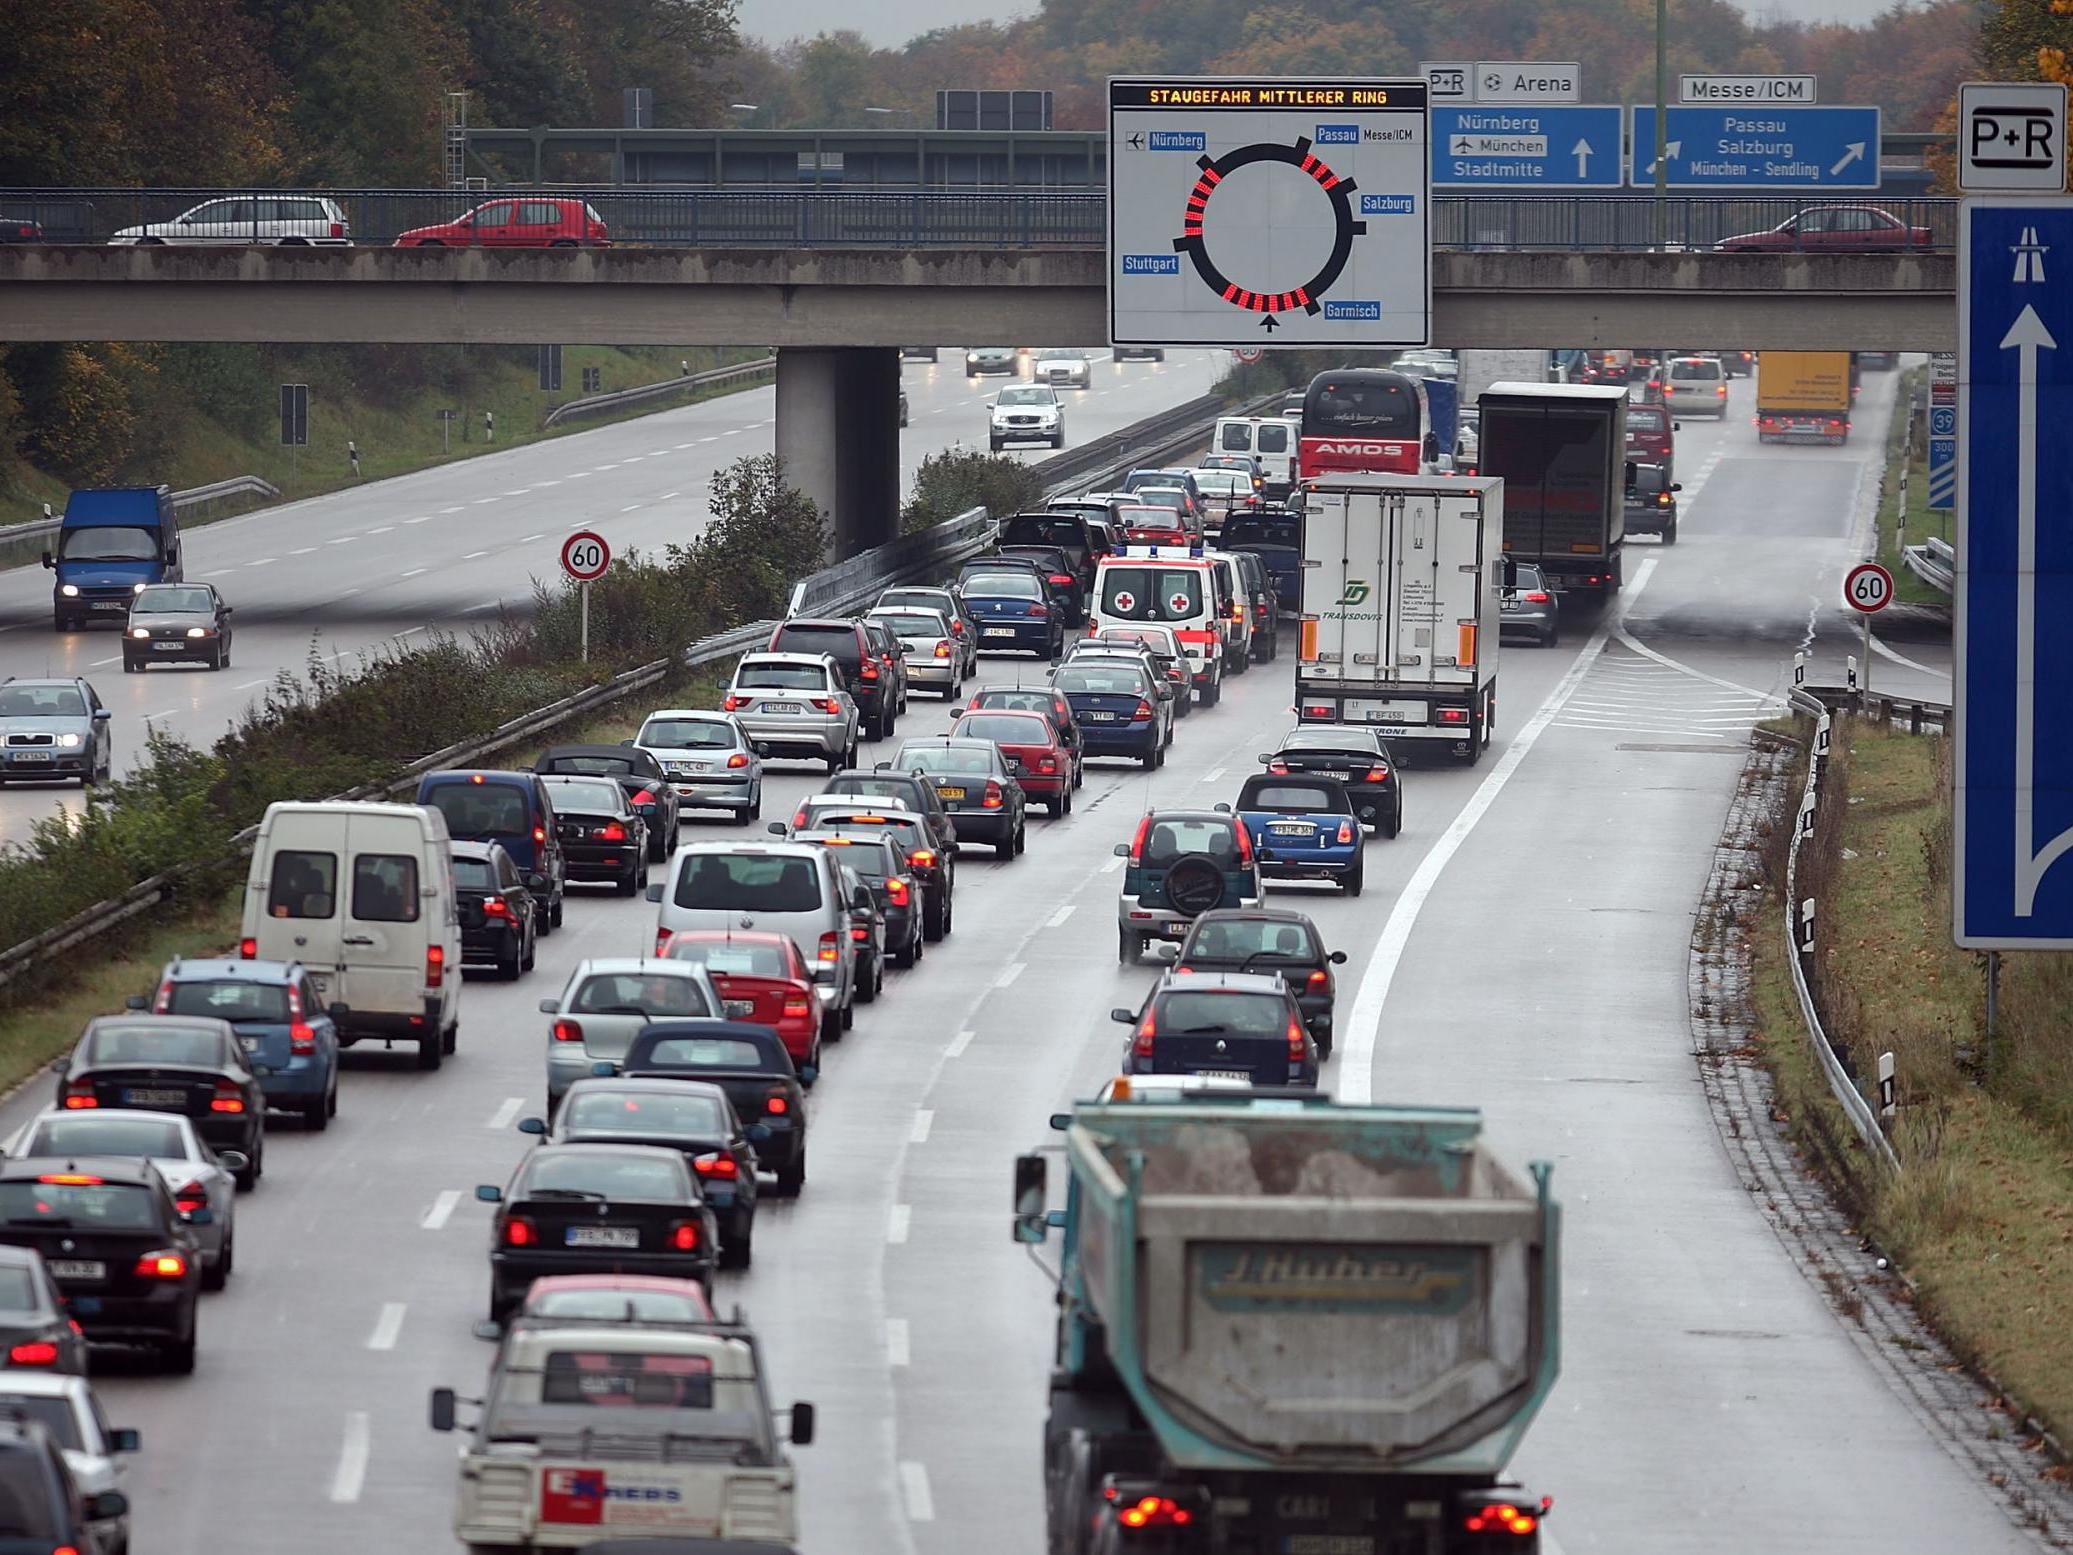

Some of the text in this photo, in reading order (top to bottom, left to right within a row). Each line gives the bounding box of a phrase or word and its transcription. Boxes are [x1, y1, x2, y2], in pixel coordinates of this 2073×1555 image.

[1429, 75, 1464, 91] P+R
[1514, 75, 1572, 92] Arena
[1692, 81, 1804, 99] Messe/ICM
[1150, 90, 1387, 104] STAUGEFAHR MITTLERER RING
[1458, 114, 1539, 134] Nürnberg
[1724, 117, 1787, 133] Passau
[1151, 132, 1204, 150] Nürnberg
[1318, 128, 1413, 142] Passau Messe/ICM
[1971, 117, 2054, 158] P+R
[1479, 137, 1543, 153] München
[1717, 140, 1794, 158] Salzburg
[1453, 161, 1544, 177] Stadtmitte
[1690, 161, 1747, 177] München
[1765, 161, 1820, 180] Sendling
[1363, 196, 1412, 213] Salzburg
[1125, 256, 1177, 273] Stuttgart
[1326, 303, 1379, 318] Garmisch
[1936, 415, 1954, 429] 39
[1315, 443, 1403, 456] AMOS
[1935, 442, 1954, 453] 300
[572, 544, 599, 567] 60
[1856, 577, 1882, 599] 60
[1321, 611, 1383, 622] TRANSDOVIS
